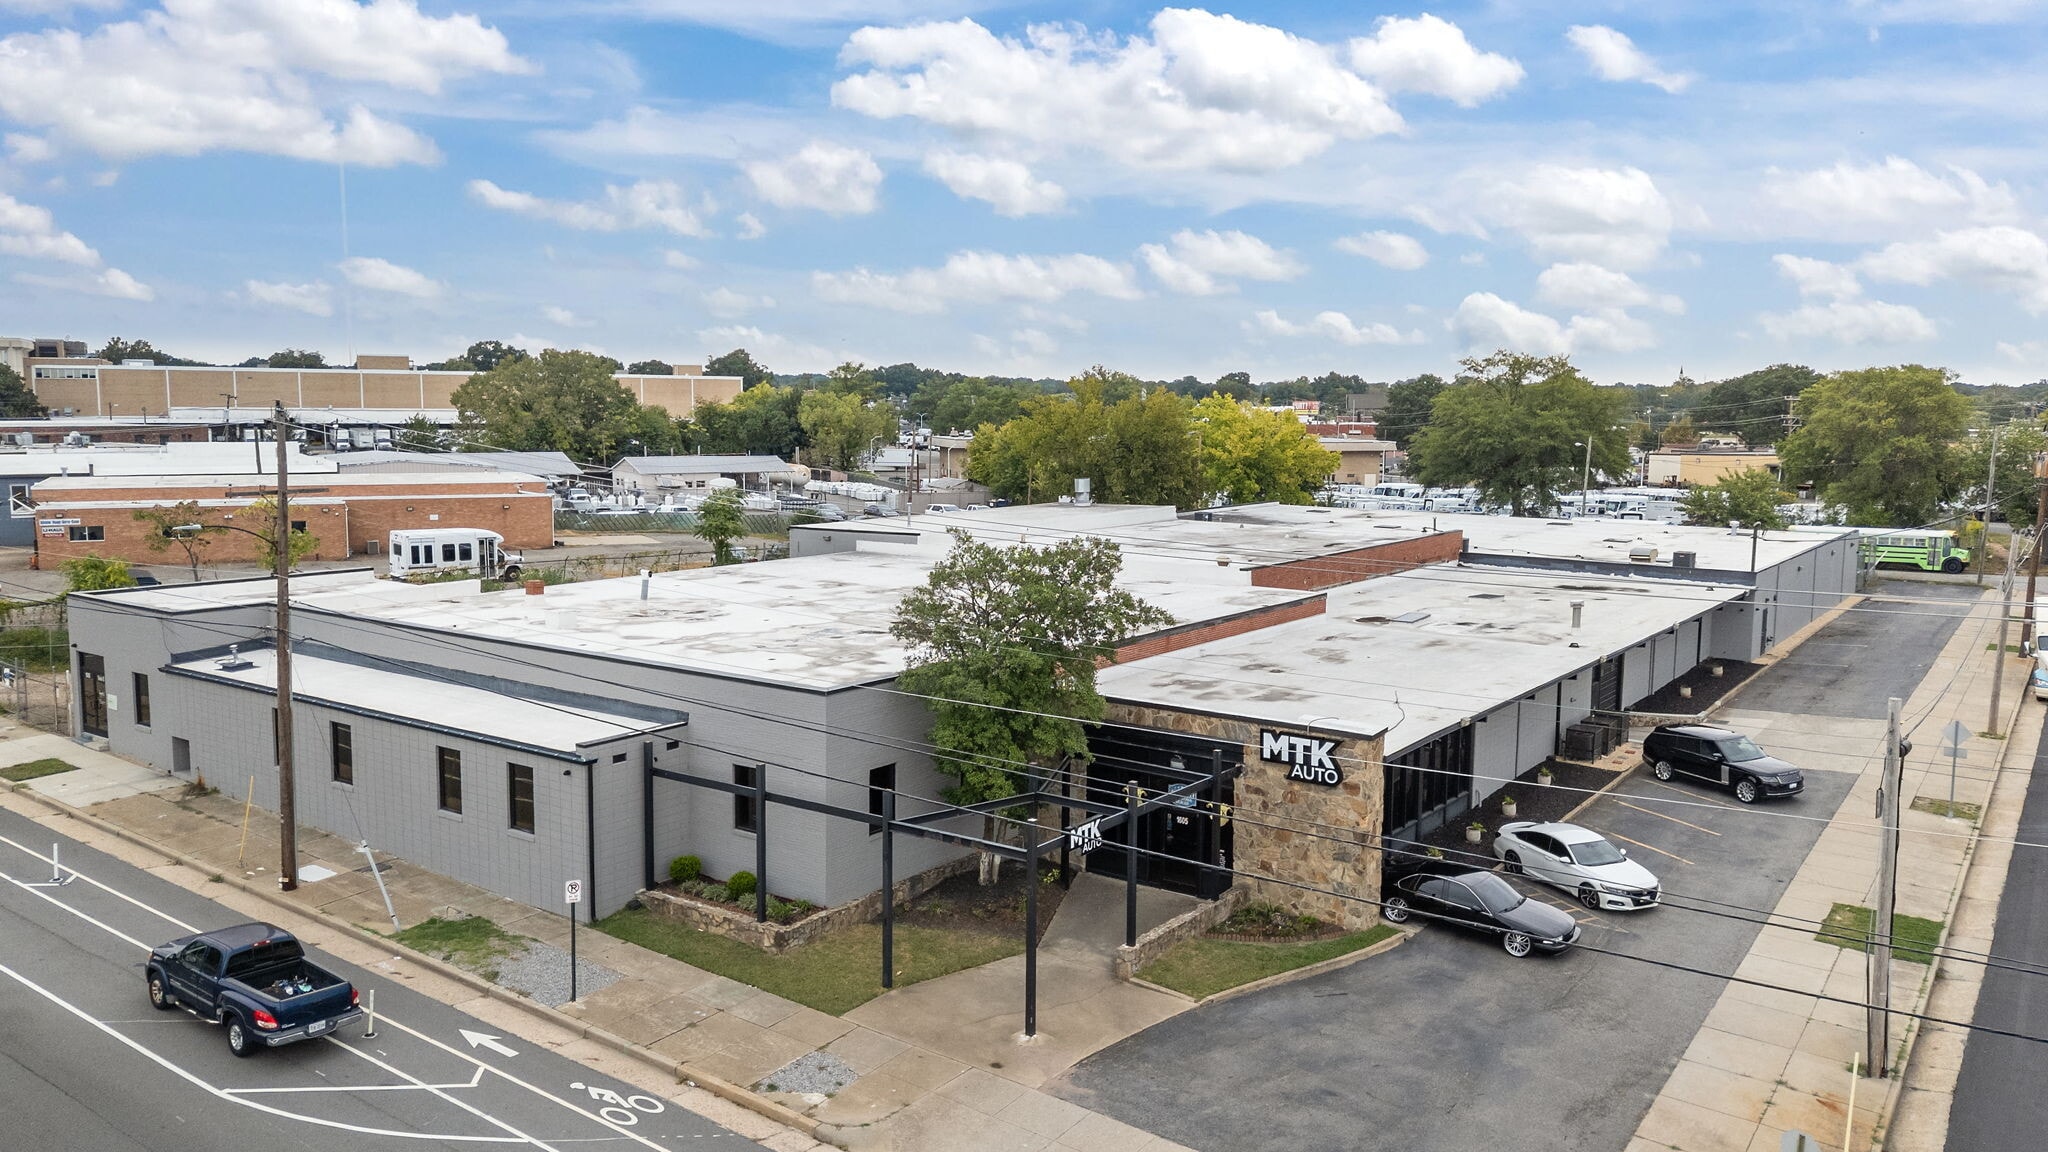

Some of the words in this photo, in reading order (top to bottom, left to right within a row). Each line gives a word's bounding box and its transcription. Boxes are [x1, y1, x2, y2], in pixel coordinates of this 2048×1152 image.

[1262, 732, 1335, 769] MTK
[1291, 764, 1339, 784] AUTO
[1070, 818, 1101, 849] MTK
[1082, 837, 1102, 854] AUTO
